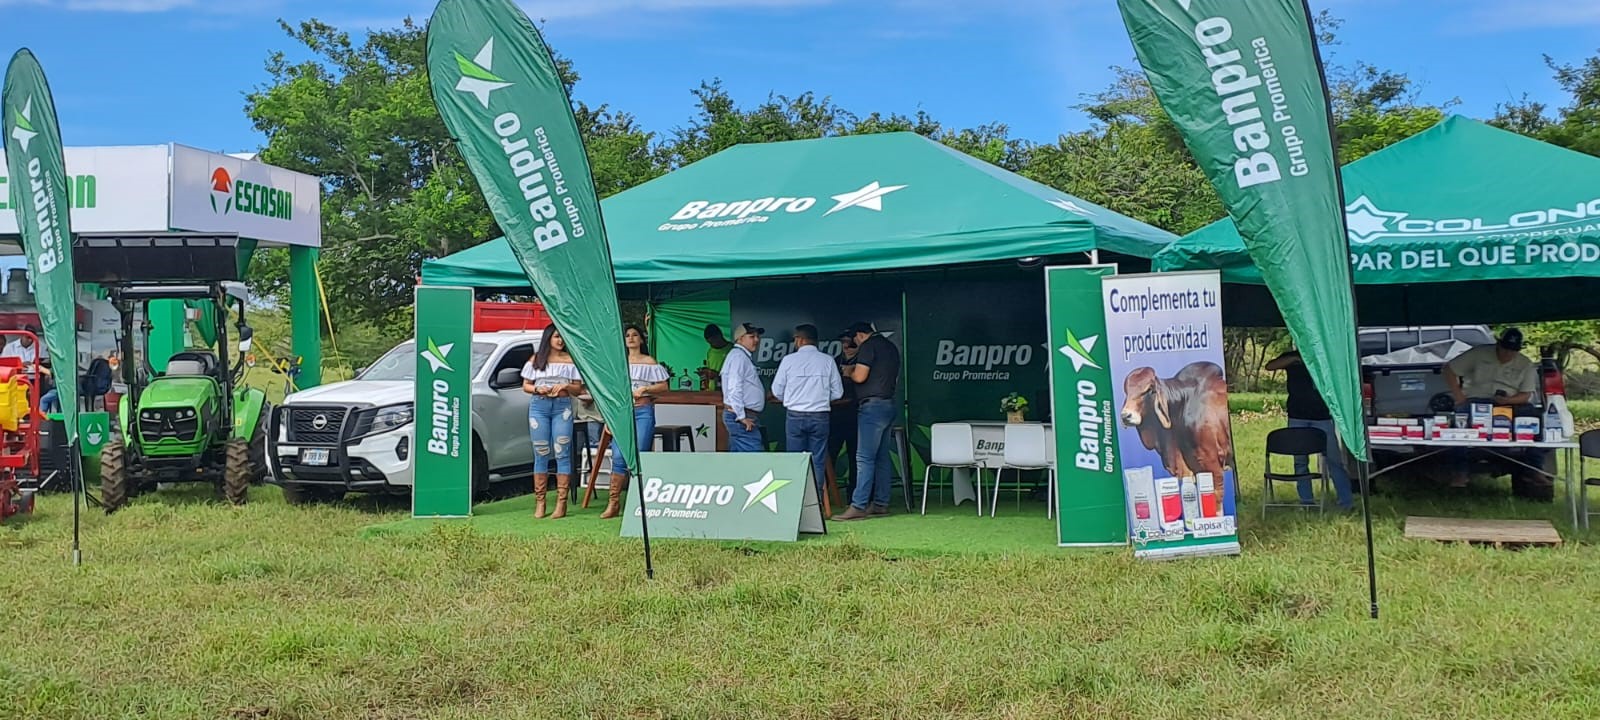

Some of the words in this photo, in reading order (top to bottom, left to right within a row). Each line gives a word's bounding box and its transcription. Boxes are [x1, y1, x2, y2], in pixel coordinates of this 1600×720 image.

[1251, 37, 1292, 122] Promerica
[1195, 16, 1282, 189] Banpro
[534, 126, 568, 196] Promerica
[1281, 125, 1309, 177] Grupo
[45, 169, 59, 228] Promerica
[235, 179, 292, 221] ESCASAN
[494, 112, 569, 252] Banpro
[28, 157, 57, 274] Banpro
[562, 196, 585, 238] Grupo
[657, 222, 699, 232] Grupo
[698, 215, 769, 229] Promerica
[669, 197, 816, 220] Banpro
[54, 228, 64, 263] Grupo
[1401, 249, 1451, 270] DEL
[1458, 246, 1516, 266] QUE
[1110, 286, 1199, 319] Complementa
[1203, 287, 1216, 308] tu
[757, 337, 842, 363] Baro
[936, 339, 1032, 371] Banpro
[1124, 323, 1208, 360] productividad
[933, 370, 960, 382] Grupo
[962, 369, 1010, 381] Promerica
[427, 379, 453, 455] Banpro
[451, 397, 460, 434] Promerica
[1075, 380, 1103, 470] Banpro
[1102, 400, 1112, 445] Promerica
[451, 435, 460, 457] Grupo
[1104, 446, 1114, 473] Grupo
[643, 477, 734, 509] Banpro
[635, 506, 660, 520] Gupo
[662, 507, 708, 519] Promerica
[1194, 521, 1222, 534] Lapisa
